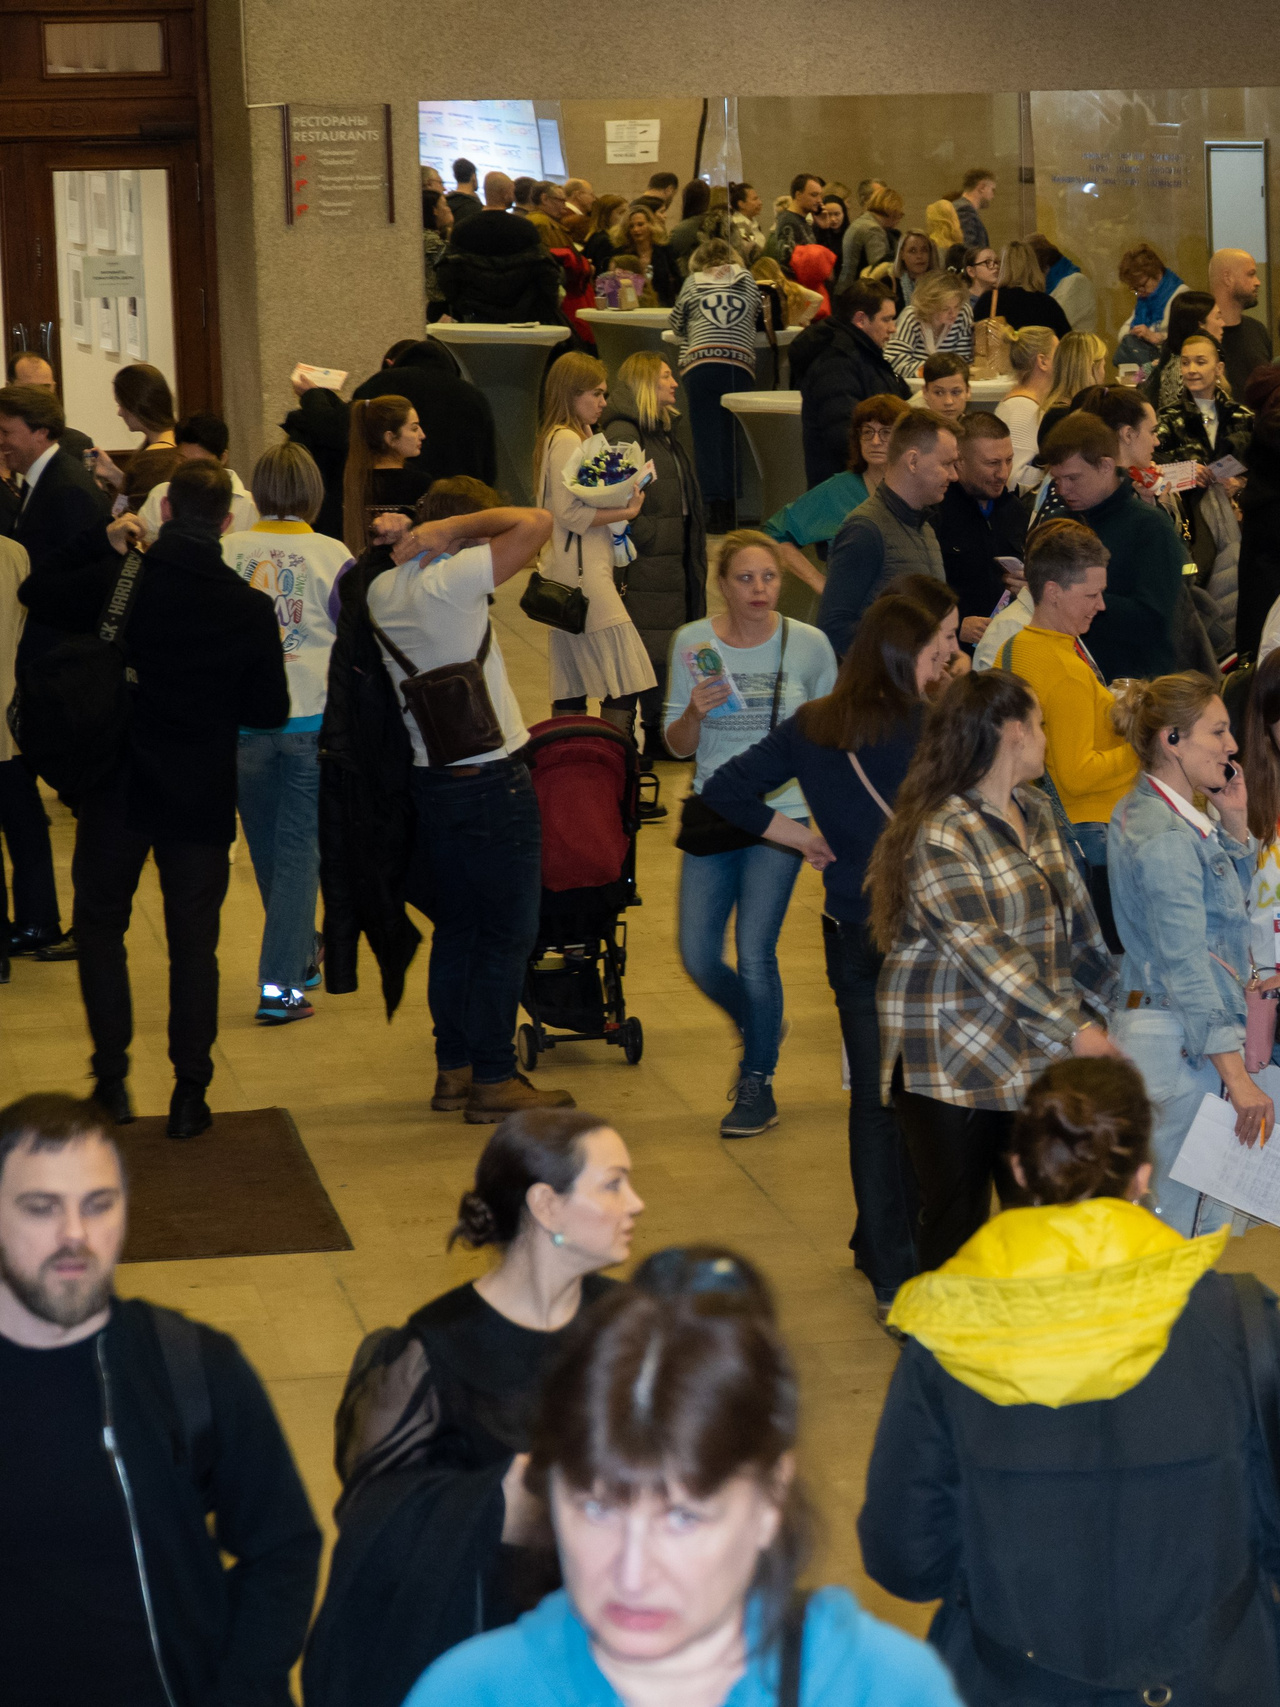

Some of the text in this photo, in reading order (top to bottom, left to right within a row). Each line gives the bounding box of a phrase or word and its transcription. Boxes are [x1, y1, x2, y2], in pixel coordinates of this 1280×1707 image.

[293, 116, 368, 127] РЕСТОРАНЫ
[293, 130, 379, 142] RESTAURANTS
[107, 577, 134, 616] HARD
